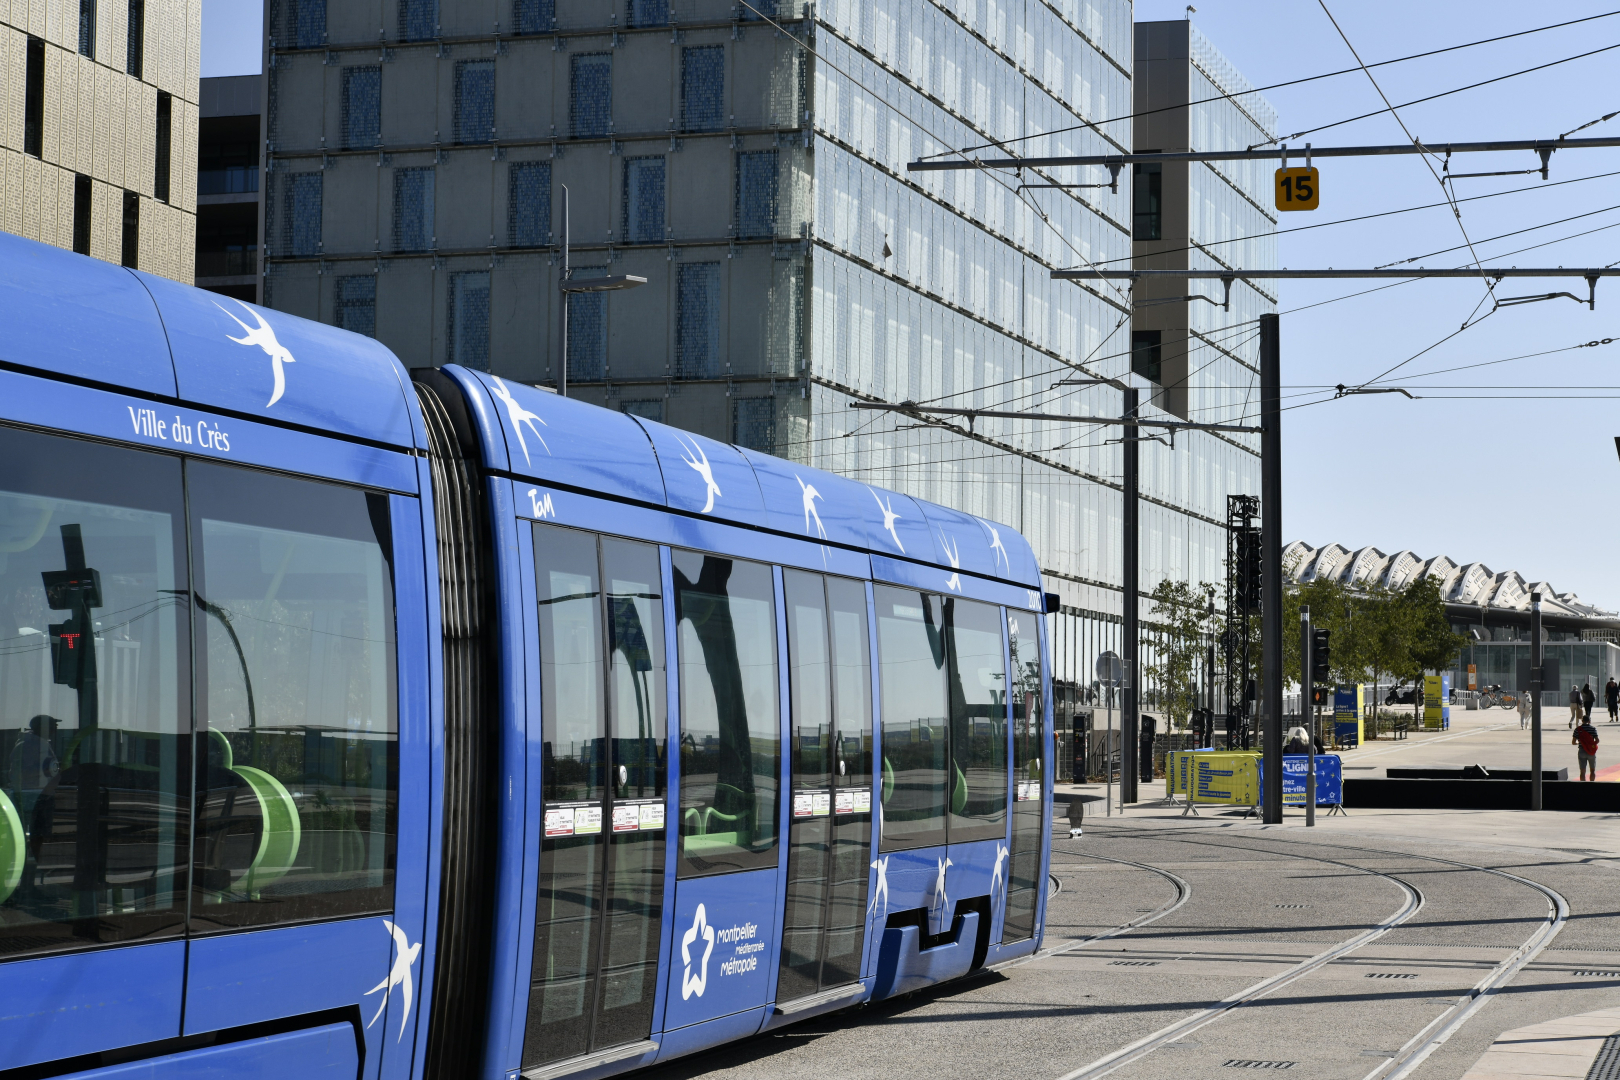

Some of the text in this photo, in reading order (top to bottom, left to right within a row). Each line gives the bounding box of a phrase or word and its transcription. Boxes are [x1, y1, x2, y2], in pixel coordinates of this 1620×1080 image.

[1280, 175, 1314, 202] 15
[127, 405, 231, 452] Ville du Crès
[527, 488, 556, 519] TaM
[717, 922, 758, 944] Montpellier
[720, 954, 757, 976] Métropole
